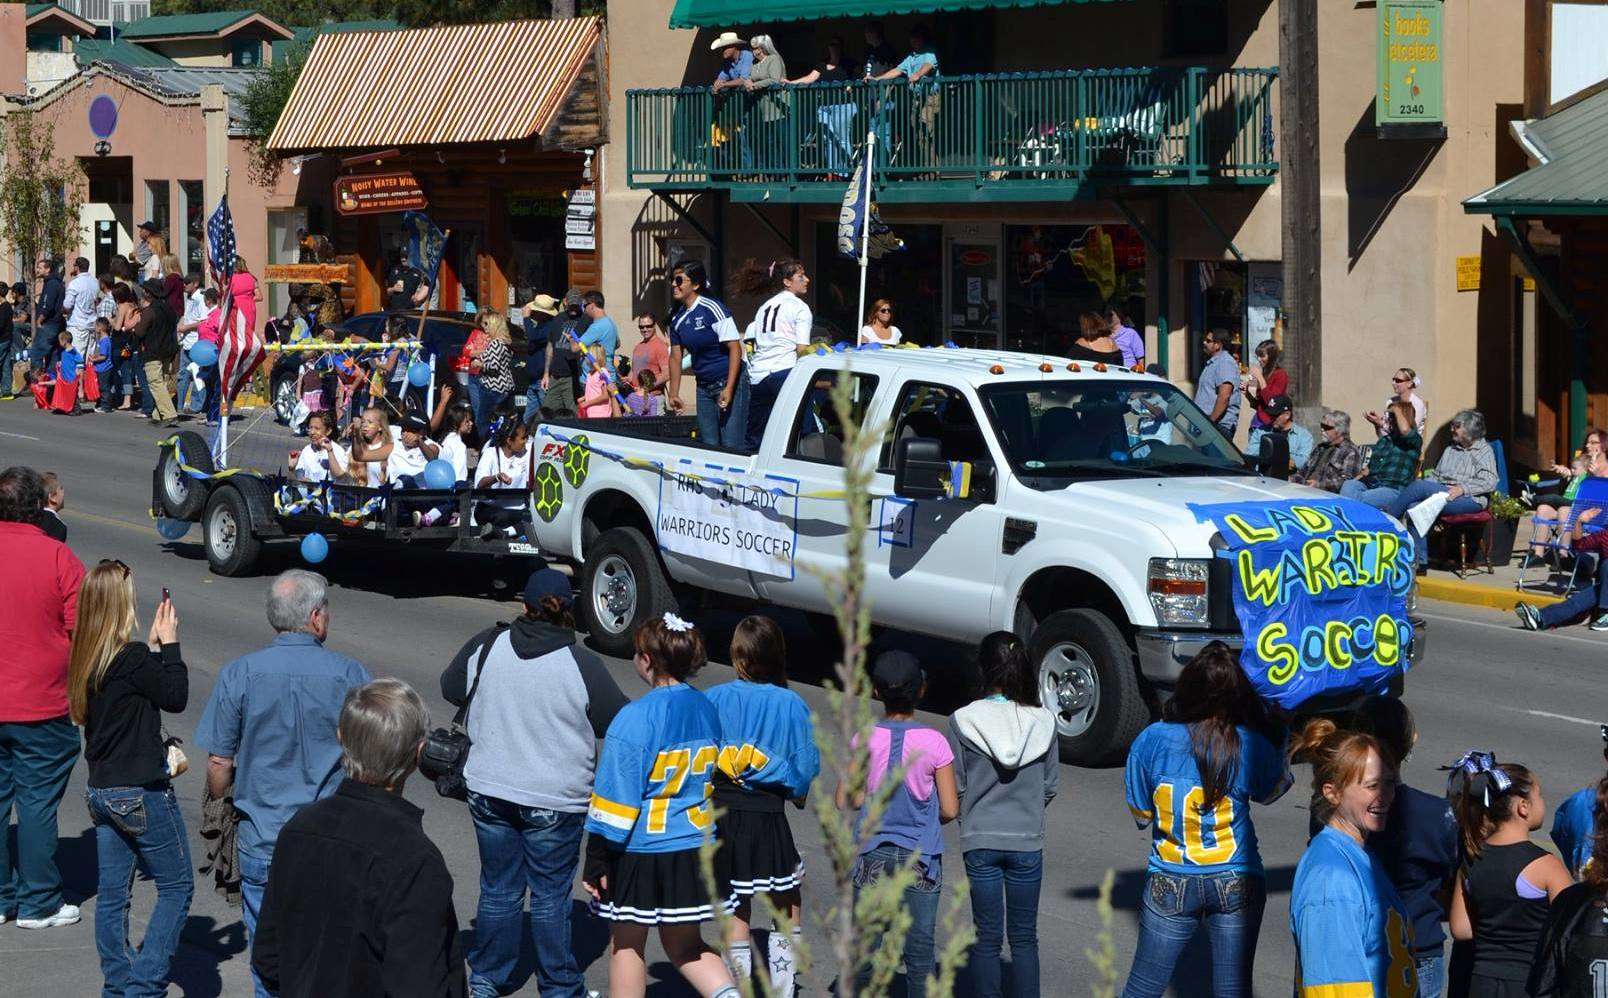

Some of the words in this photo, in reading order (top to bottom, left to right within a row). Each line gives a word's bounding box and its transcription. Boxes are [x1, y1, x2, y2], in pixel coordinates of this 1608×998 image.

[1394, 9, 1431, 37] books
[1400, 105, 1424, 114] 2340
[351, 180, 372, 192] NOISY
[373, 178, 397, 189] WATER
[762, 303, 782, 334] 11
[676, 473, 704, 495] RHS
[742, 486, 780, 510] LADY
[661, 513, 731, 545] WARRIORS
[736, 530, 791, 559] SOCCER
[890, 517, 904, 534] 12
[1224, 505, 1358, 544] LADY
[1152, 782, 1238, 866] 10
